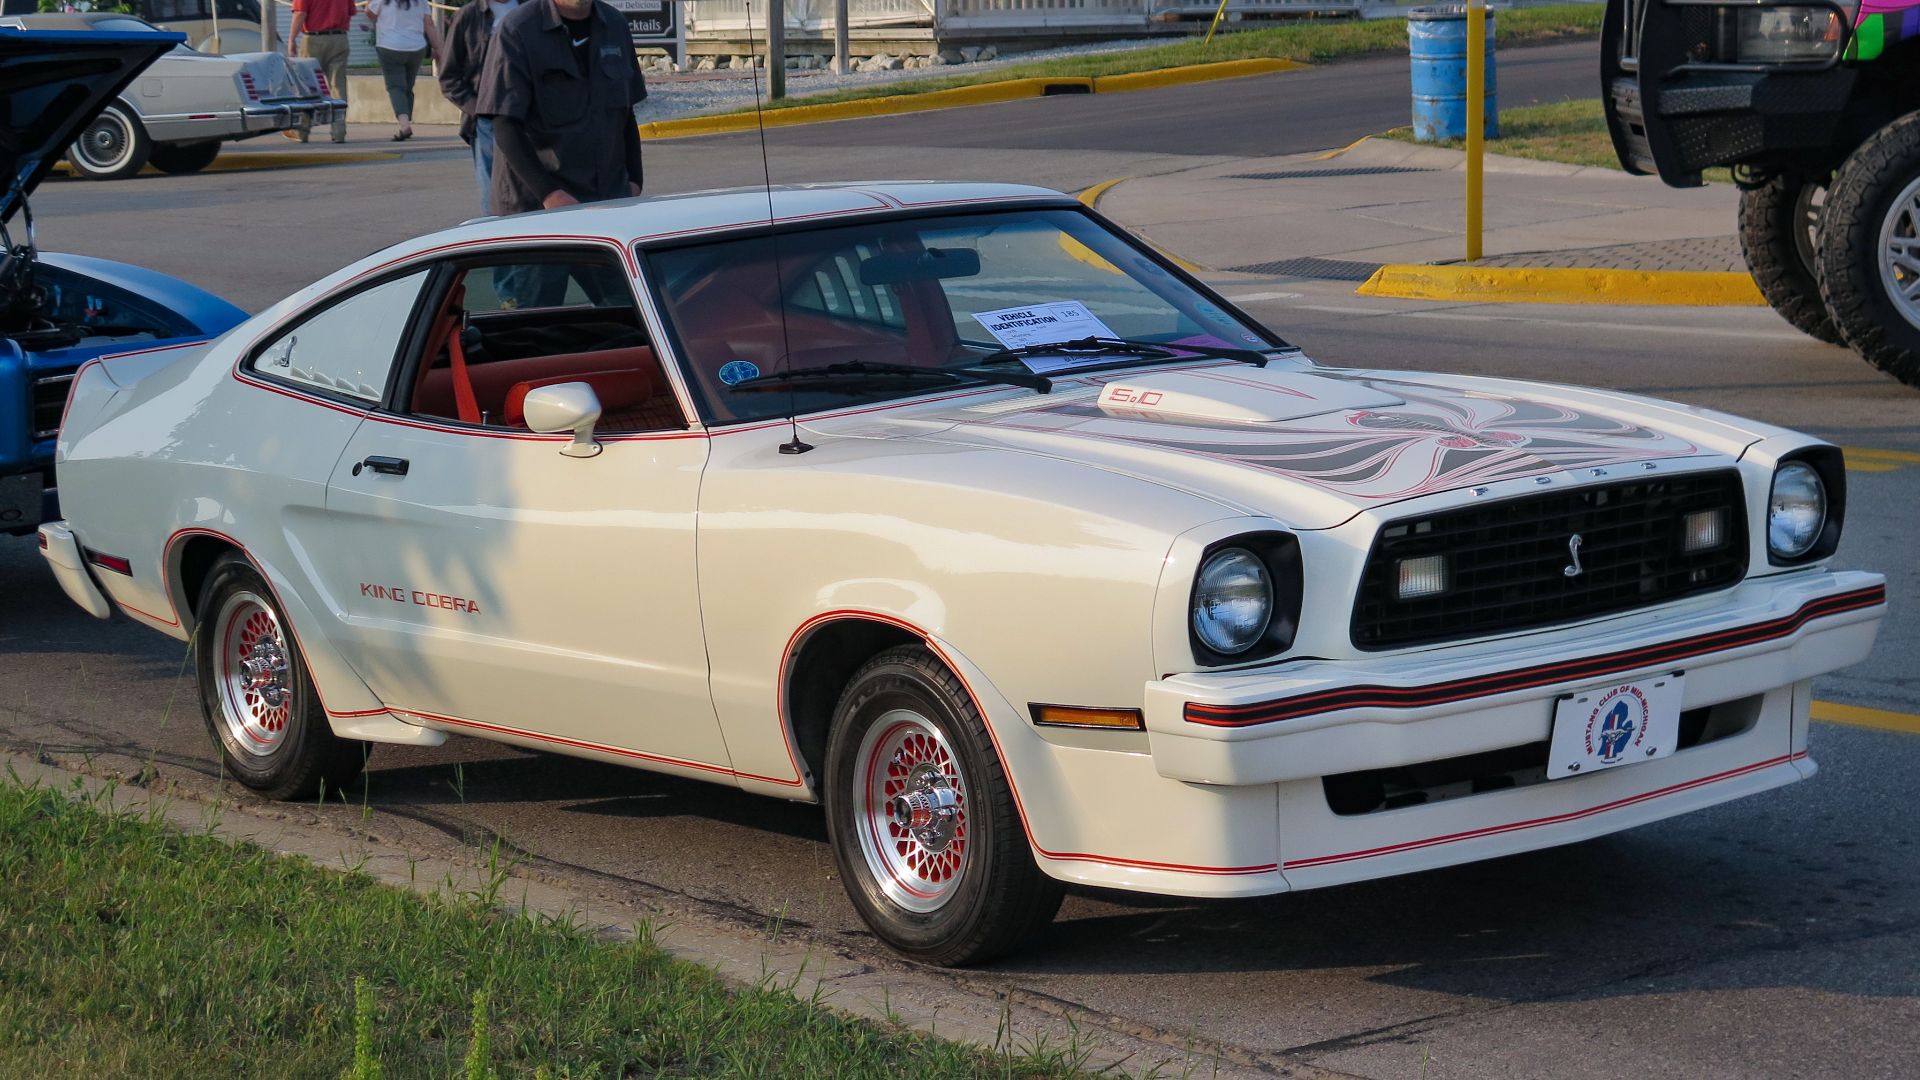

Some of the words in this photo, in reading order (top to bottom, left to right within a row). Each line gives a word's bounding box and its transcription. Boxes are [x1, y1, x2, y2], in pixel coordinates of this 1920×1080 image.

[628, 19, 661, 31] cktails
[991, 316, 1058, 331] IDENTIFICATION
[997, 311, 1036, 321] VEHICLE
[1109, 388, 1163, 406] 5.0
[360, 583, 406, 602] KING
[412, 591, 481, 615] COBRA
[1585, 708, 1599, 754] MUSTANG
[1599, 688, 1618, 706] CLUB
[1631, 687, 1649, 746] MID-MICHIGAN
